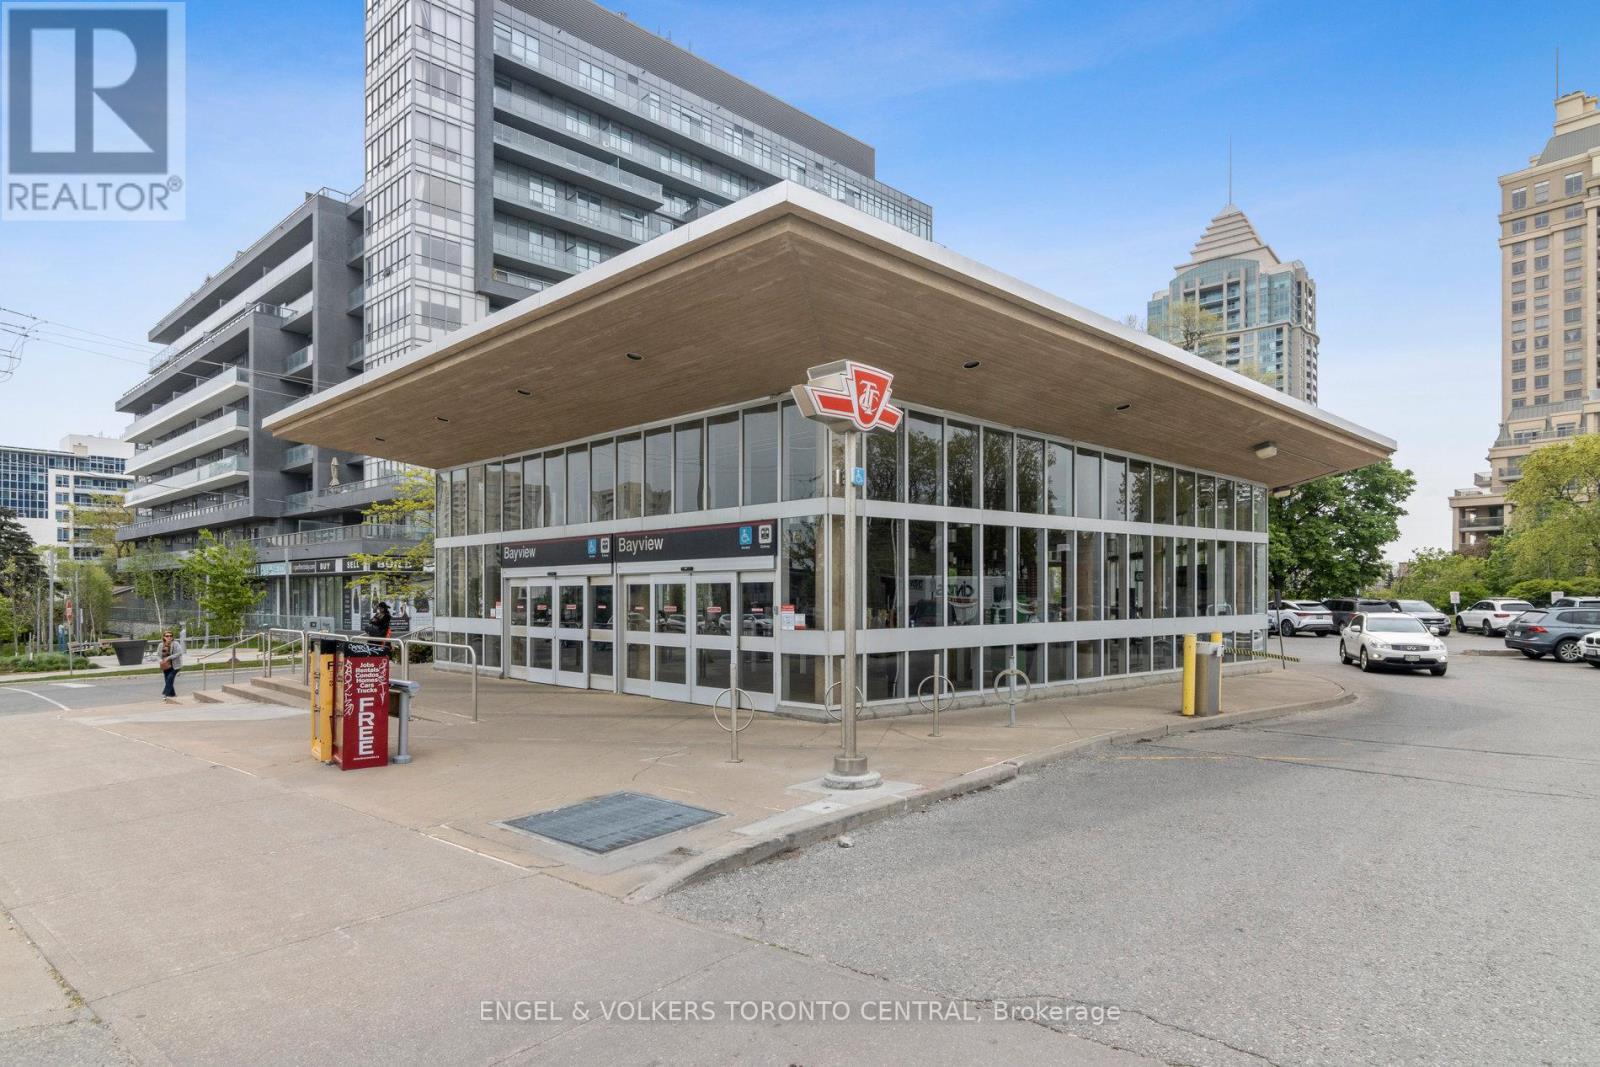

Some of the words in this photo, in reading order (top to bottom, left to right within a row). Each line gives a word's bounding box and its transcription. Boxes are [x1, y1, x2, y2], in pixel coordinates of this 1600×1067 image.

[503, 545, 536, 562] Bayview
[618, 535, 664, 556] Bayview
[319, 562, 331, 570] BUY
[346, 561, 360, 569] SELL
[358, 697, 375, 756] FREE
